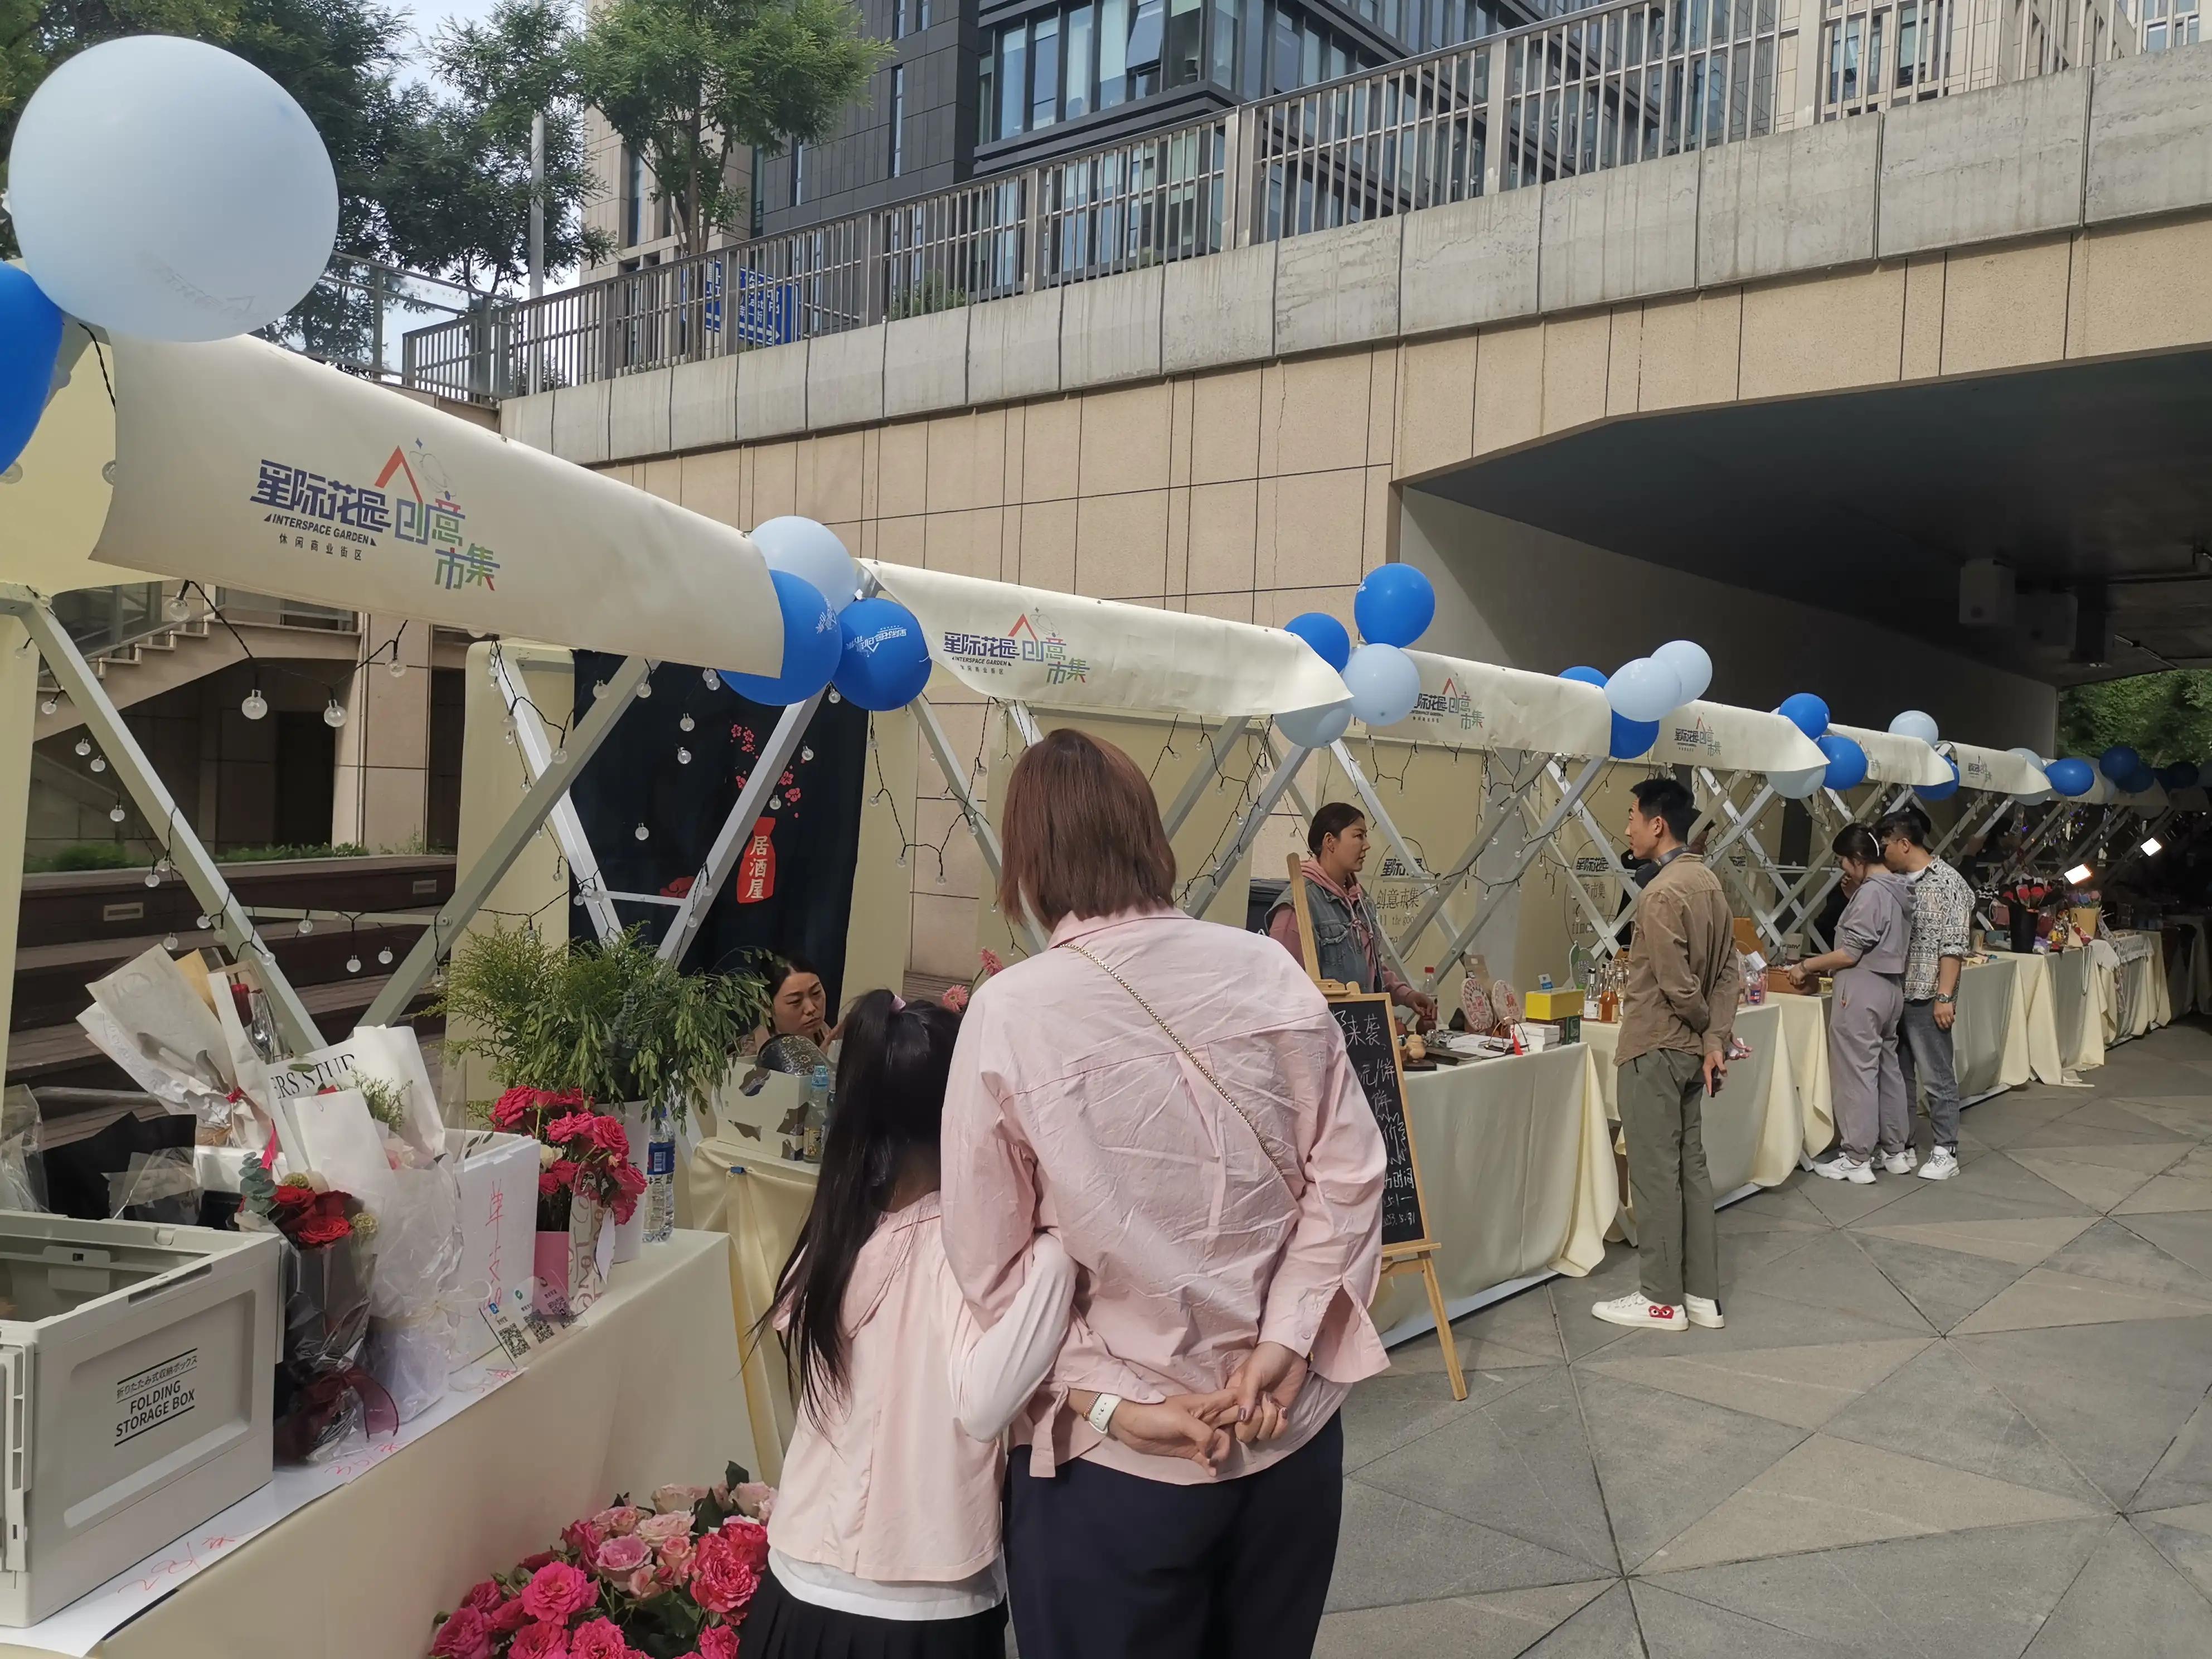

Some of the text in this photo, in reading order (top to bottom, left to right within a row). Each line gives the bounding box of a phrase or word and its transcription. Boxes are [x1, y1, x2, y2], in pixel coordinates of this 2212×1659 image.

[250, 459, 392, 533] 星际花园
[272, 514, 369, 545] INTERSPACE GARDEN
[279, 533, 362, 561] 休闲商业街区
[435, 544, 501, 591] 市集
[943, 632, 1020, 659] 星际花园
[954, 656, 985, 664] INTERSPACE
[1046, 657, 1090, 685] 市集
[1414, 693, 1448, 711] 际花园
[745, 835, 769, 899] 居酒屋
[1380, 857, 1425, 876] 星际
[1376, 887, 1419, 910] 创意市集
[116, 1355, 197, 1400] 折りたたみ式収納ボックス
[130, 1380, 181, 1414] FOLDING
[116, 1388, 195, 1437] STORAGE BOX
